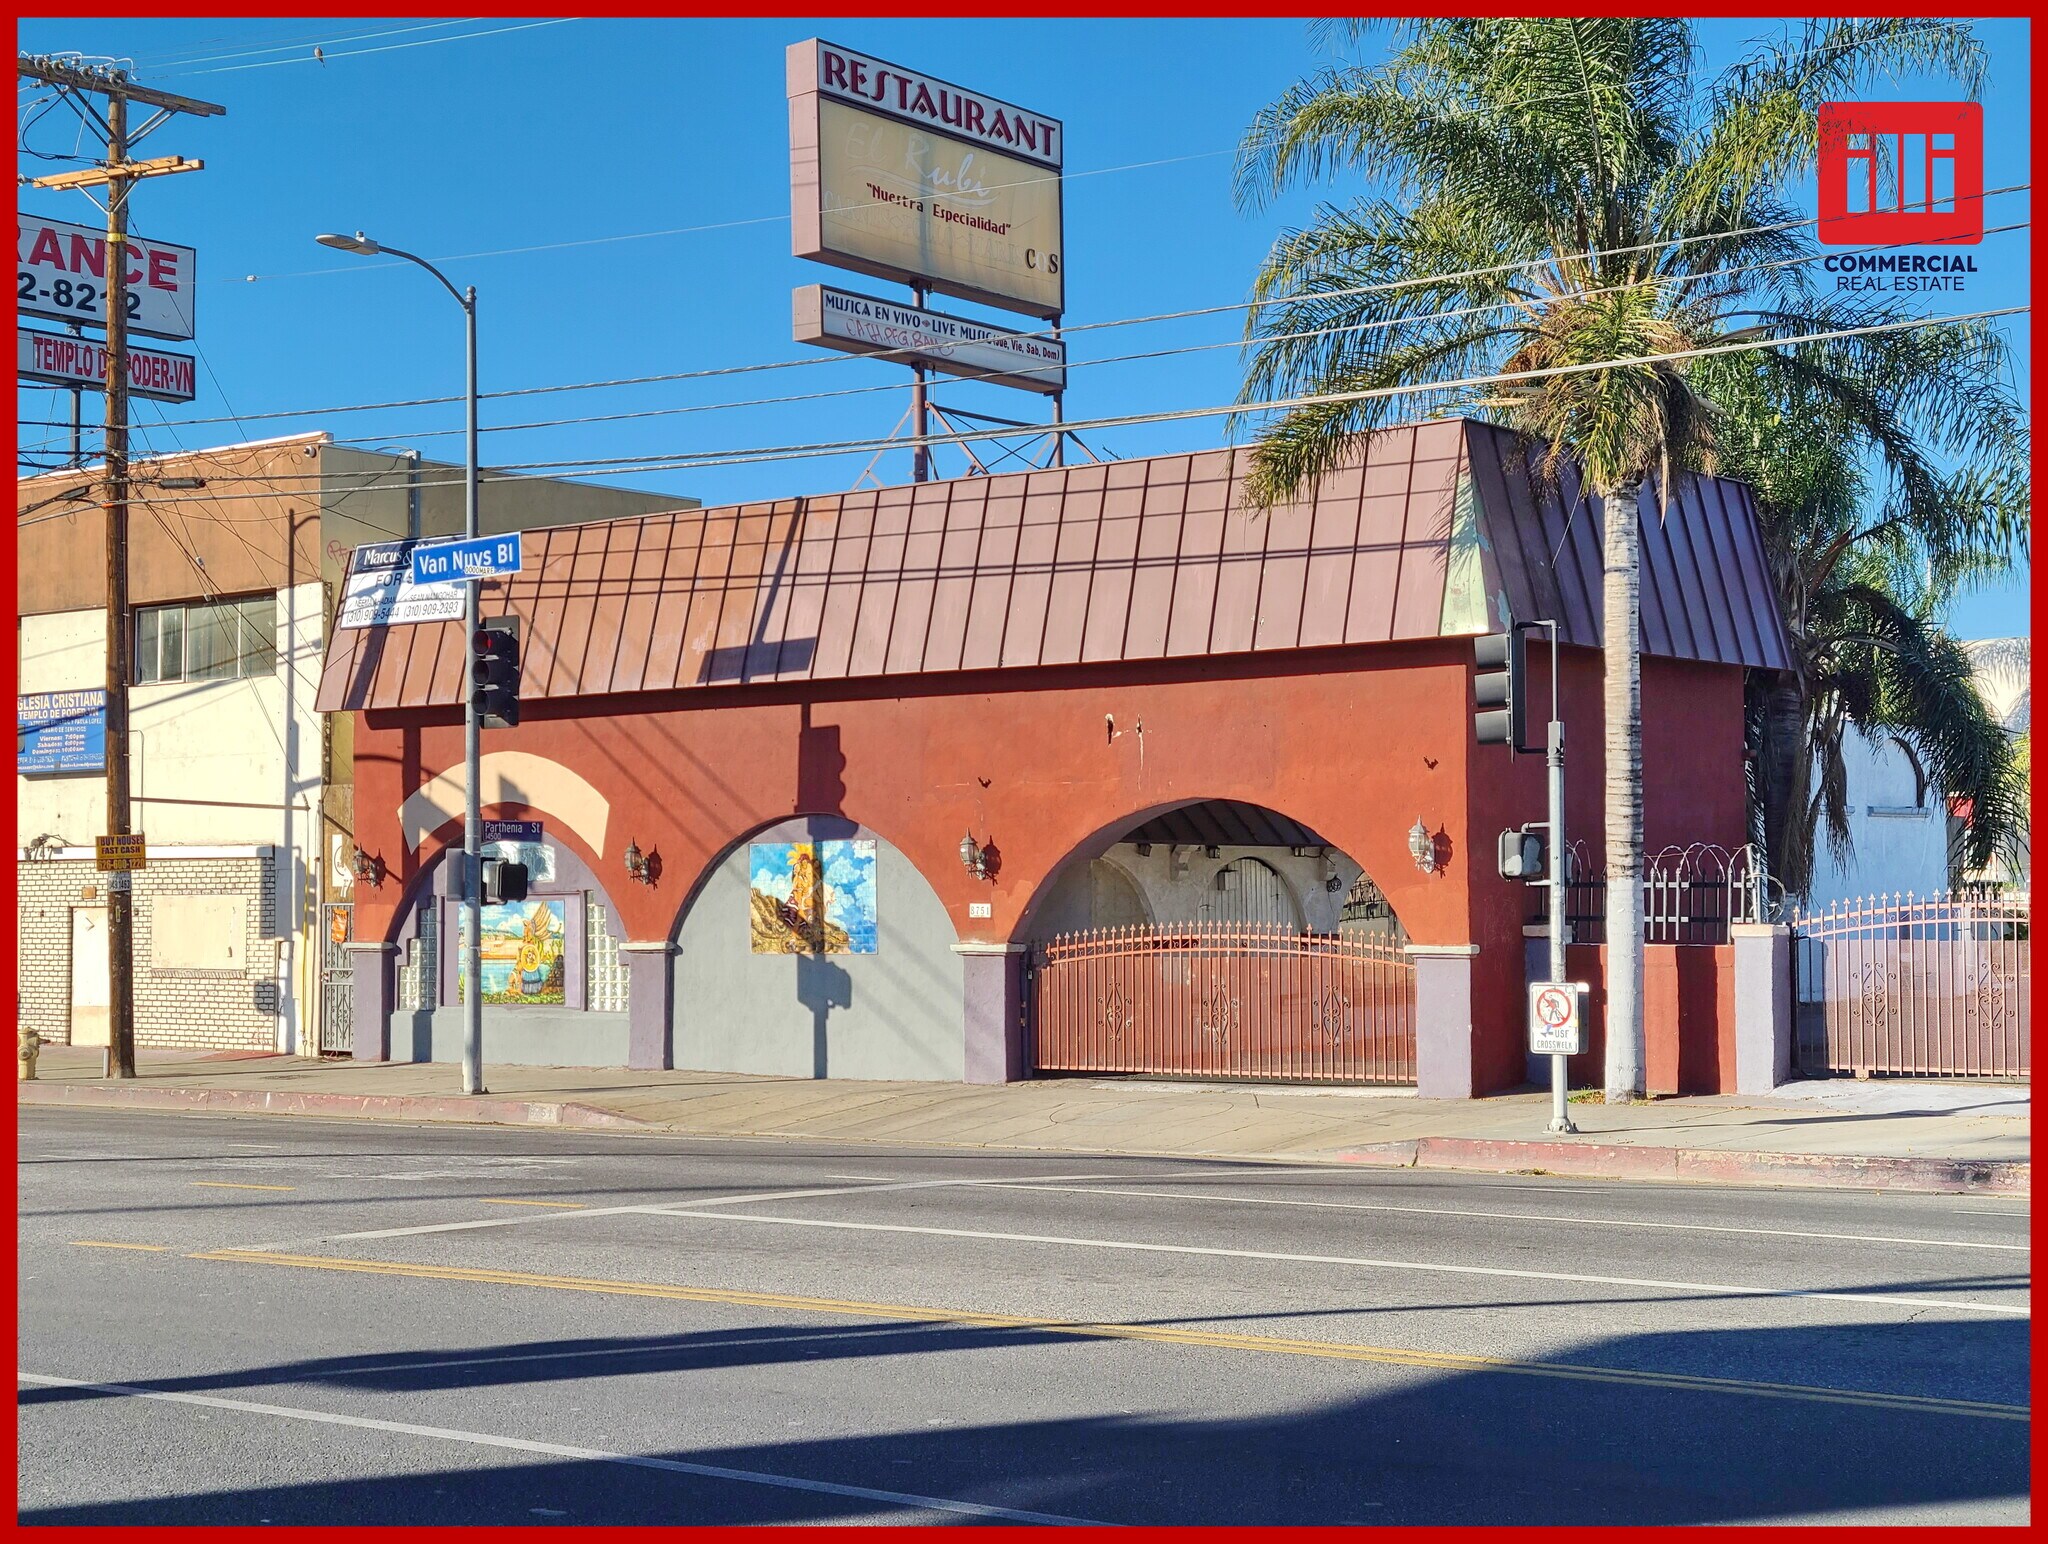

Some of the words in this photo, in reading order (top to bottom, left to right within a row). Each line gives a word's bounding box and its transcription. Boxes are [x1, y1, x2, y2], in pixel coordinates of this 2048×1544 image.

[823, 51, 1055, 156] RESTAURANT
[866, 182, 924, 213] "Nuestra
[933, 204, 1012, 235] Especialidad"
[17, 226, 178, 293] ANCE
[825, 293, 870, 316] MUSICA
[875, 305, 890, 321] EN
[893, 310, 921, 328] VIVO
[932, 319, 956, 337] LIVE
[33, 336, 94, 378] TEMPLO
[363, 549, 402, 566] Marcus
[419, 555, 448, 575] Van
[452, 548, 492, 571] Nuys
[497, 543, 514, 564] Bl
[375, 572, 402, 588] FOR
[346, 609, 363, 625] (310)
[364, 606, 400, 621] 909-5444
[403, 604, 421, 619] (310)
[423, 600, 459, 616] 909-2393
[52, 691, 104, 709] CRISTIANA
[18, 709, 48, 720] TEMPLO
[50, 709, 60, 719] DE
[484, 821, 523, 834] Parthenia
[531, 823, 540, 834] St
[484, 833, 502, 841] 14500
[101, 847, 118, 855] FAST
[120, 845, 141, 854] CASH
[970, 905, 989, 916] 8751
